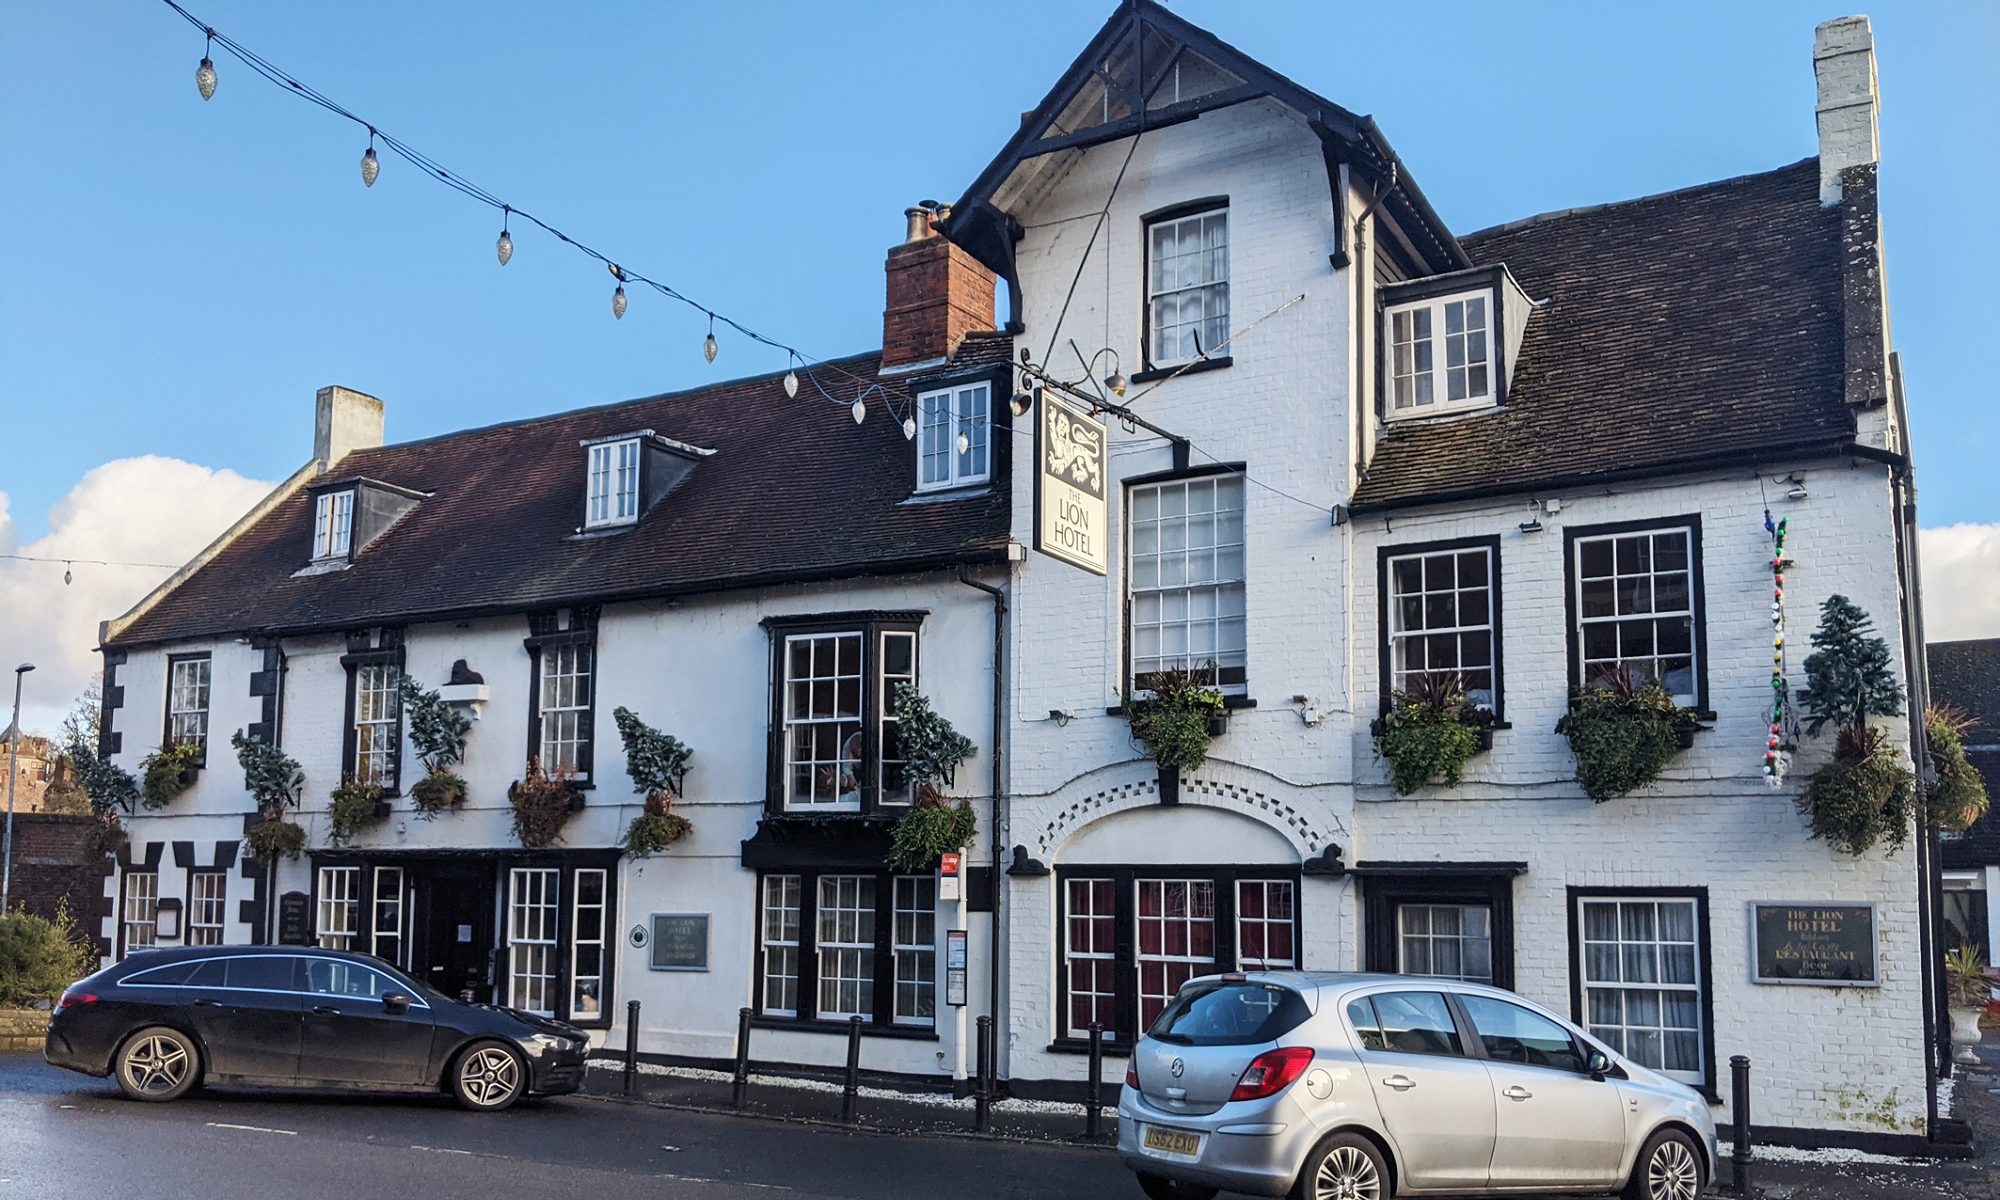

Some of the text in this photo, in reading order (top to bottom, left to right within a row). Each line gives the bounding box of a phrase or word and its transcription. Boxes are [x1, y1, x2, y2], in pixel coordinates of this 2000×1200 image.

[1068, 489, 1082, 504] THE
[1060, 498, 1089, 529] LION
[1055, 521, 1093, 556] HOTEL
[1787, 910, 1844, 921] THE LION
[1787, 920, 1841, 932] HOTEL
[1775, 949, 1856, 961] RESTAURANT
